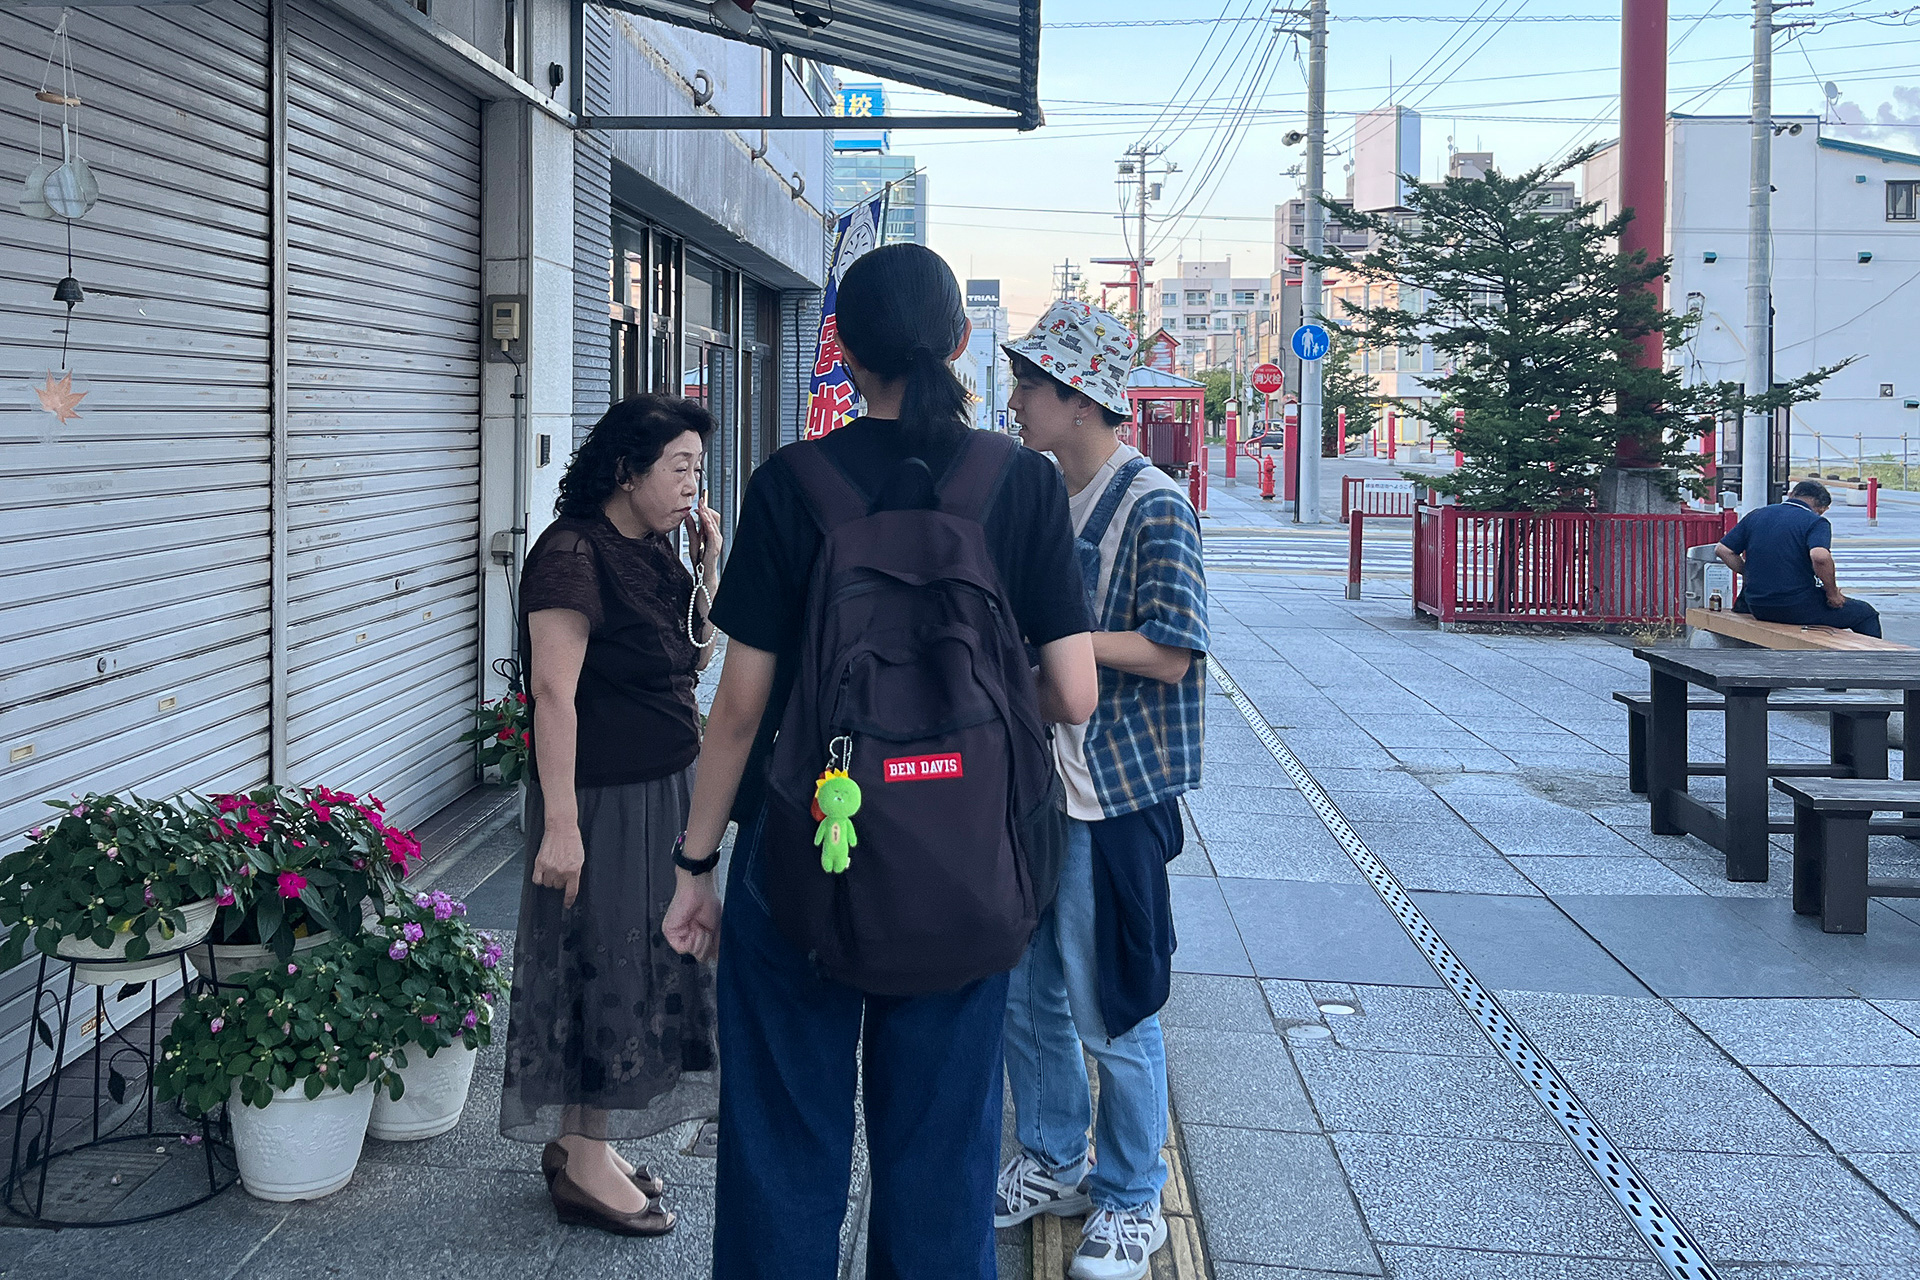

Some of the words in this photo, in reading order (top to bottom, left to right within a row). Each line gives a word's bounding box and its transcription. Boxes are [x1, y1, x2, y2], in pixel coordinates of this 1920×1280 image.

[967, 294, 999, 302] TRIAL
[1254, 373, 1282, 385] 消火栓
[889, 762, 916, 776] BEN
[920, 759, 958, 774] DAVIS
